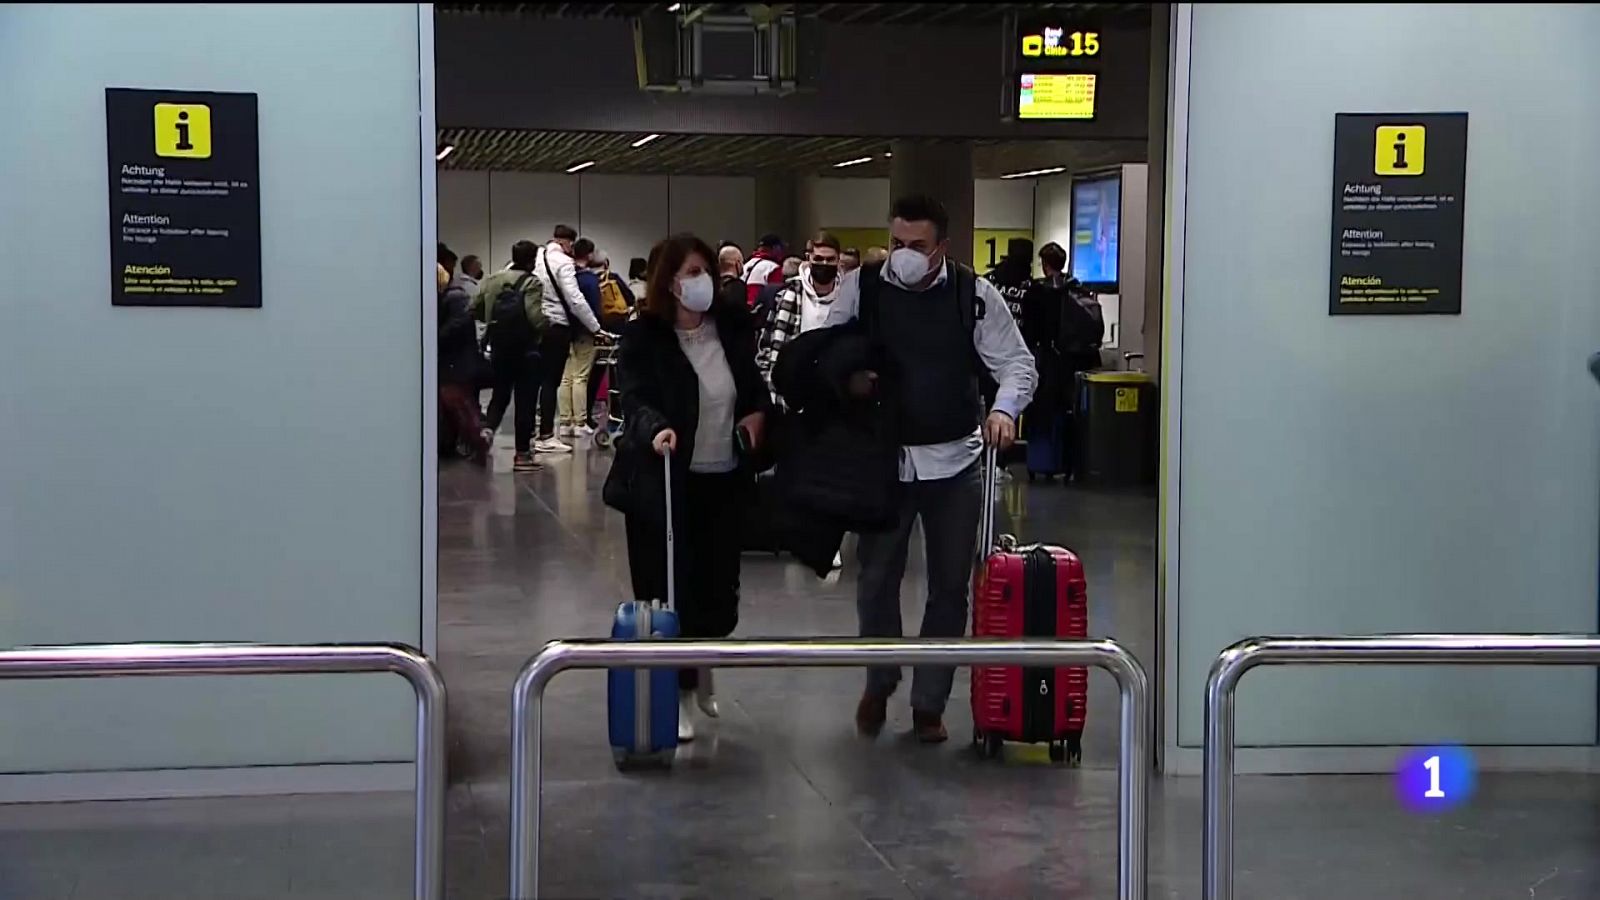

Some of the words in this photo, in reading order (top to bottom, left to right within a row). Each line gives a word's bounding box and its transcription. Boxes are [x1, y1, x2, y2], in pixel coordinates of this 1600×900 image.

[1070, 31, 1099, 55] 15
[121, 164, 165, 177] Achtung
[1344, 184, 1381, 195] Achtung
[123, 213, 170, 225] Attention
[1342, 228, 1383, 240] Attention
[125, 264, 171, 275] Atención
[1341, 275, 1382, 285] Atención
